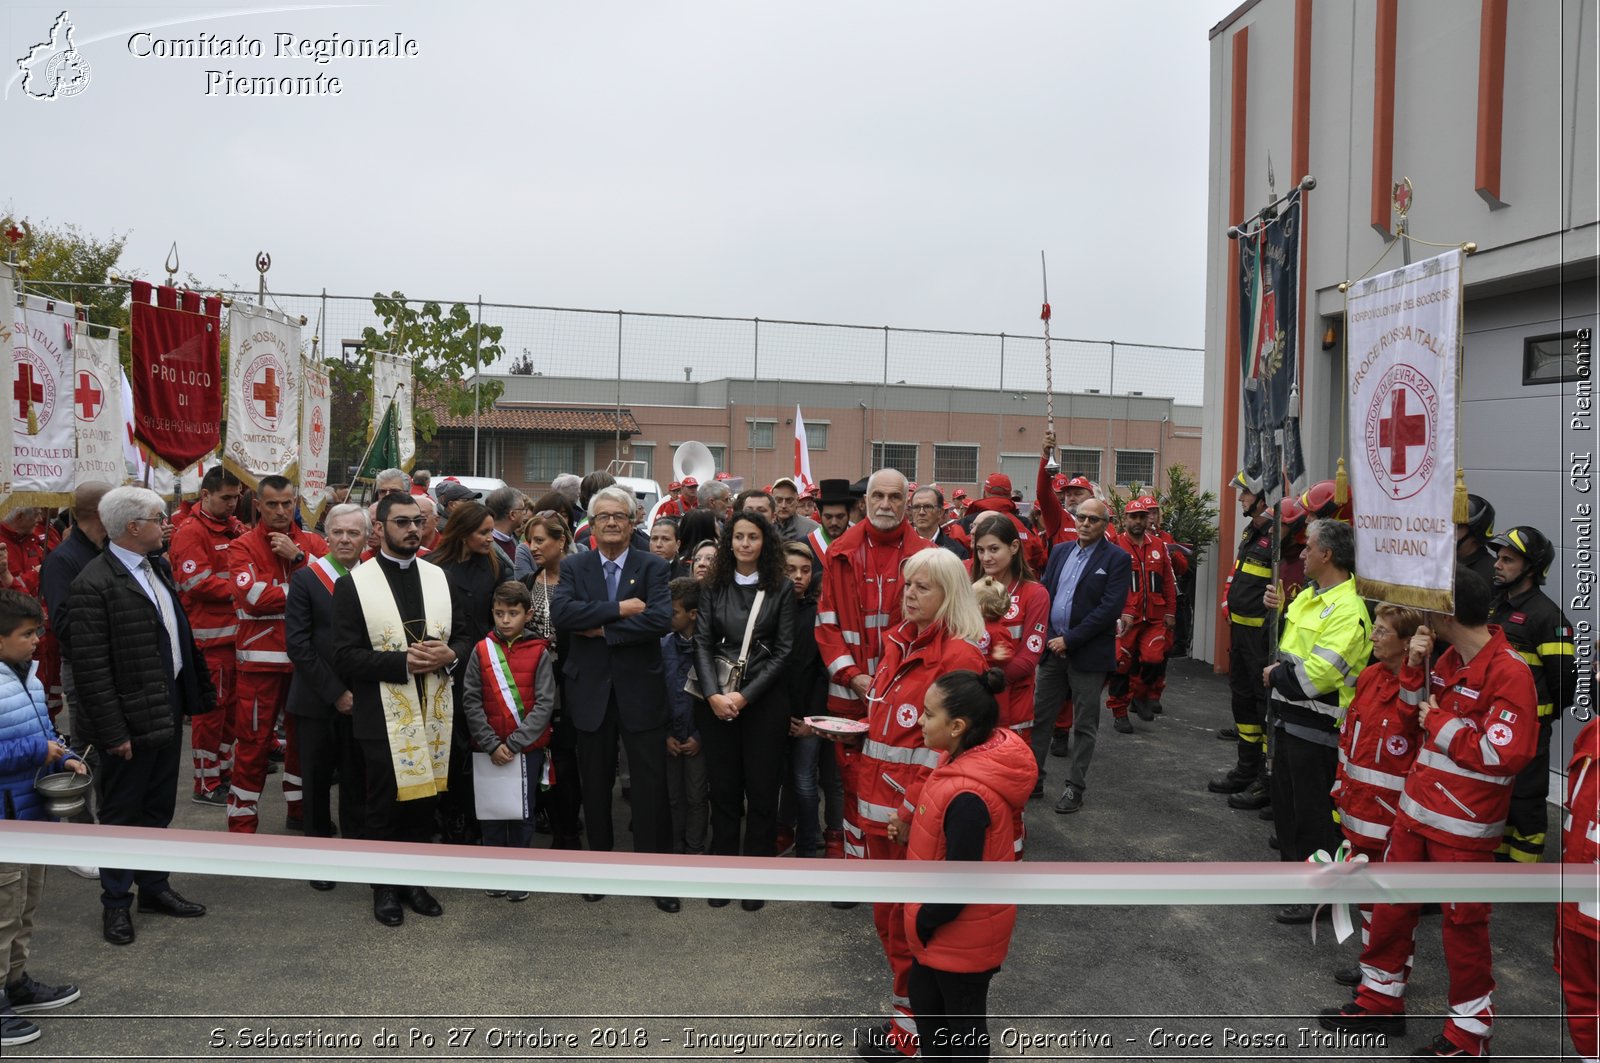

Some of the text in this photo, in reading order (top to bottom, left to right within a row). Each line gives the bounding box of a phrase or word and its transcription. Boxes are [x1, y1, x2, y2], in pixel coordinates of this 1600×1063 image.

[1380, 325, 1412, 351] ROSSA
[151, 364, 211, 387] PRO LOCO
[1416, 378, 1430, 396] 22
[179, 393, 189, 406] DI
[1367, 395, 1385, 481] CONVENZIONE
[1420, 455, 1435, 481] 1864
[1357, 513, 1447, 534] COMITATO LOCALE
[1375, 537, 1429, 557] LAURIANO
